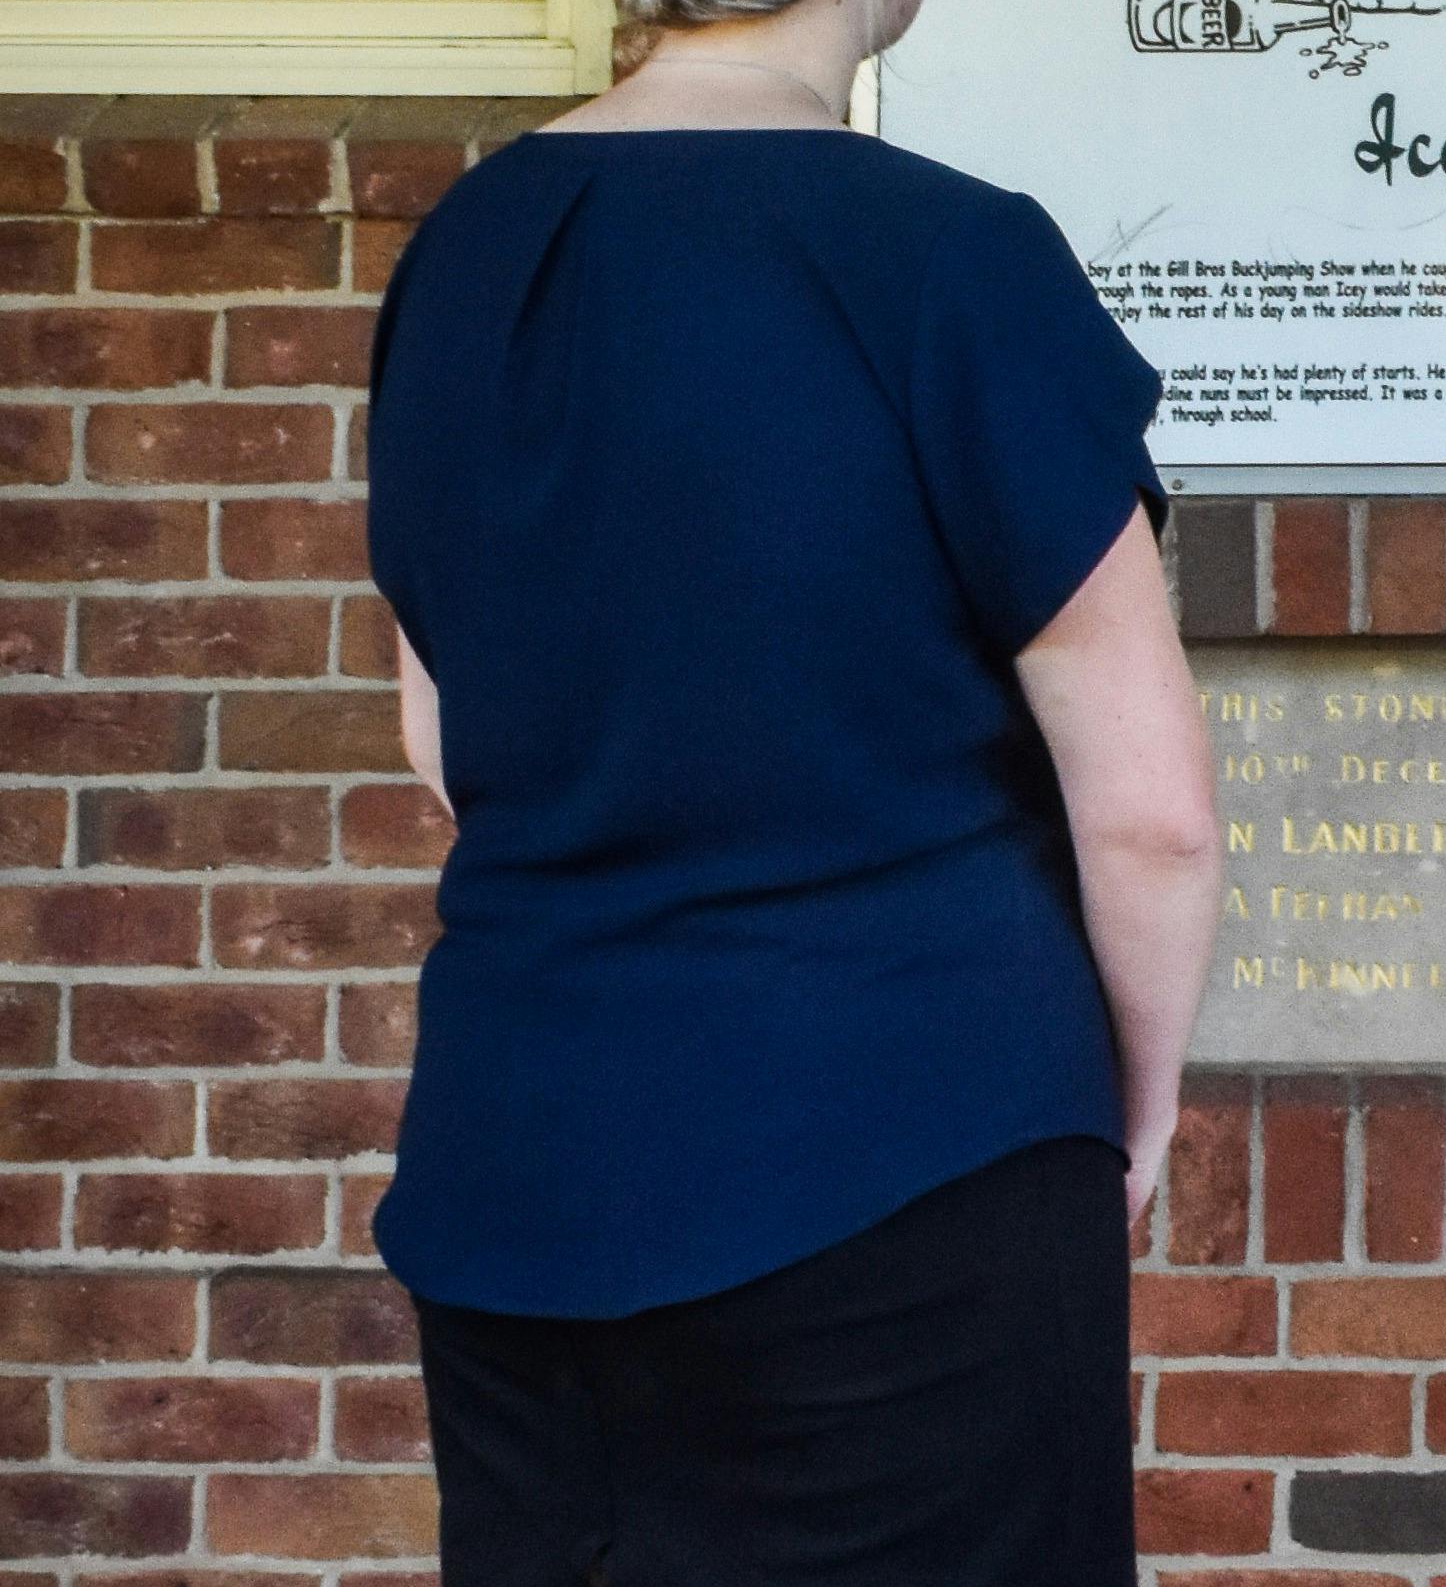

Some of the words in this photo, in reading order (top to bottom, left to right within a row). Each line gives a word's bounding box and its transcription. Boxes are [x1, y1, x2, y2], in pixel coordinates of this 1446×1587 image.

[1088, 259, 1112, 282] boy
[1117, 259, 1133, 278] at
[1138, 259, 1161, 278] the
[1167, 259, 1189, 278] Gill
[1195, 258, 1226, 277] Bros
[1231, 258, 1314, 281] Buckjumping
[1320, 258, 1356, 277] Show
[1361, 257, 1395, 276] when
[1401, 257, 1417, 276] he
[1141, 280, 1164, 299] the
[1170, 285, 1212, 303] ropes.
[1220, 279, 1238, 298] As
[1244, 284, 1252, 298] a
[1259, 284, 1297, 302] young
[1304, 284, 1330, 298] man
[1336, 279, 1367, 302] Icey
[1374, 278, 1411, 297] would
[1148, 300, 1171, 319] the
[1177, 300, 1207, 319] rest
[1212, 300, 1228, 319] of
[1234, 300, 1255, 319] his
[1260, 299, 1285, 322] day
[1289, 304, 1307, 318] on
[1312, 299, 1335, 318] the
[1343, 299, 1403, 318] sideshow
[1171, 363, 1207, 382] could
[1212, 368, 1236, 386] say
[1241, 363, 1268, 382] he's
[1273, 362, 1298, 381] had
[1302, 362, 1346, 385] plenty
[1352, 362, 1367, 381] of
[1373, 362, 1420, 381] starts.
[1427, 361, 1446, 380] He
[1200, 388, 1229, 402] nuns
[1237, 383, 1269, 402] must
[1276, 383, 1292, 402] be
[1381, 382, 1396, 401] It
[1402, 387, 1428, 401] was
[1434, 387, 1442, 401] a
[1171, 404, 1225, 427] through
[1230, 403, 1277, 422] school.
[1229, 821, 1255, 854] N
[1222, 887, 1249, 921] A
